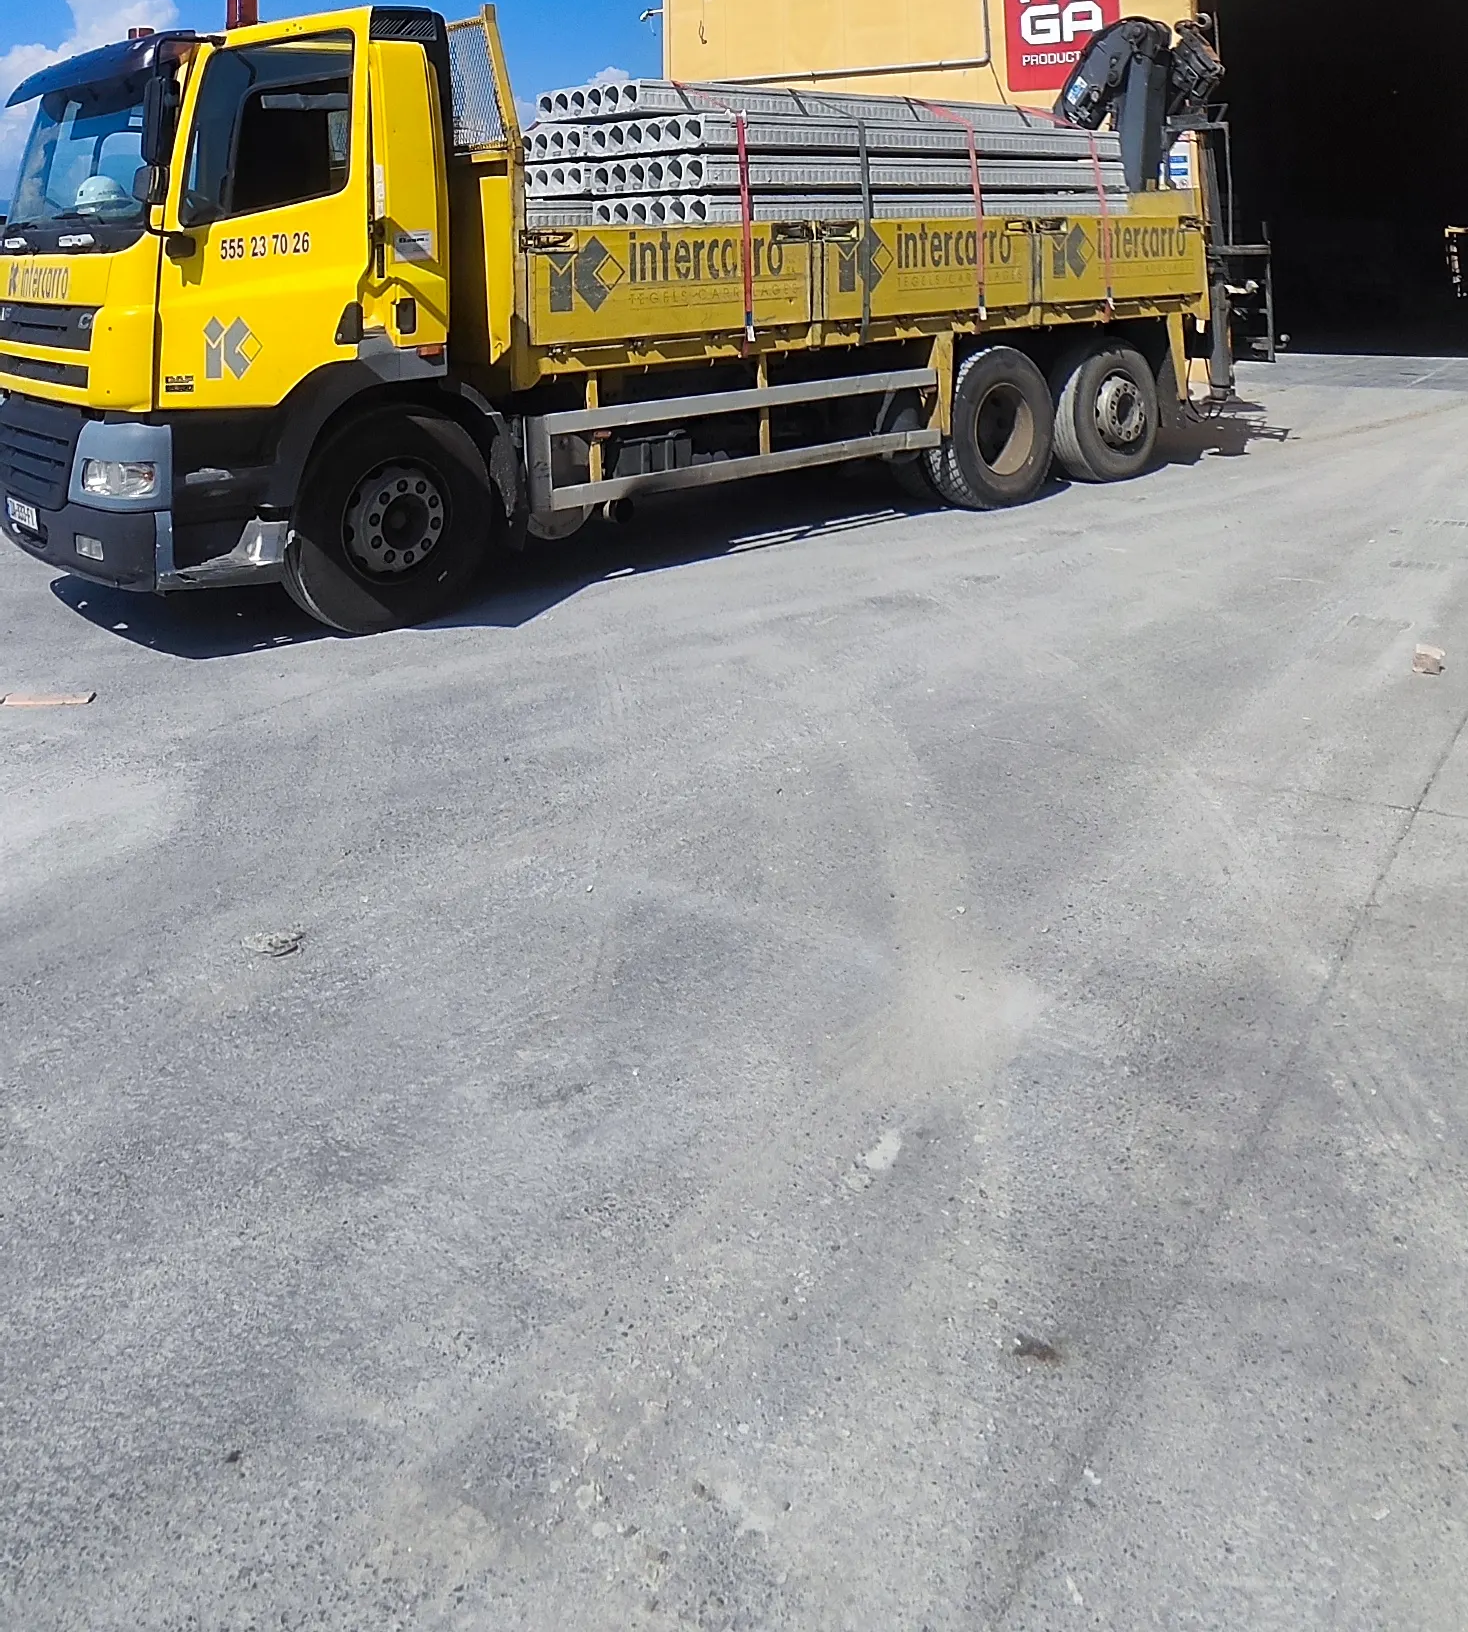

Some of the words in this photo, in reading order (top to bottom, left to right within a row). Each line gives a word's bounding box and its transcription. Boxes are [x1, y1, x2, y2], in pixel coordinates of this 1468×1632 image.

[1020, 0, 1104, 45] GA
[1022, 50, 1082, 66] PRODUCT
[220, 237, 244, 260] 555
[250, 235, 267, 257] 23
[272, 233, 288, 255] 70
[293, 231, 310, 253] 26
